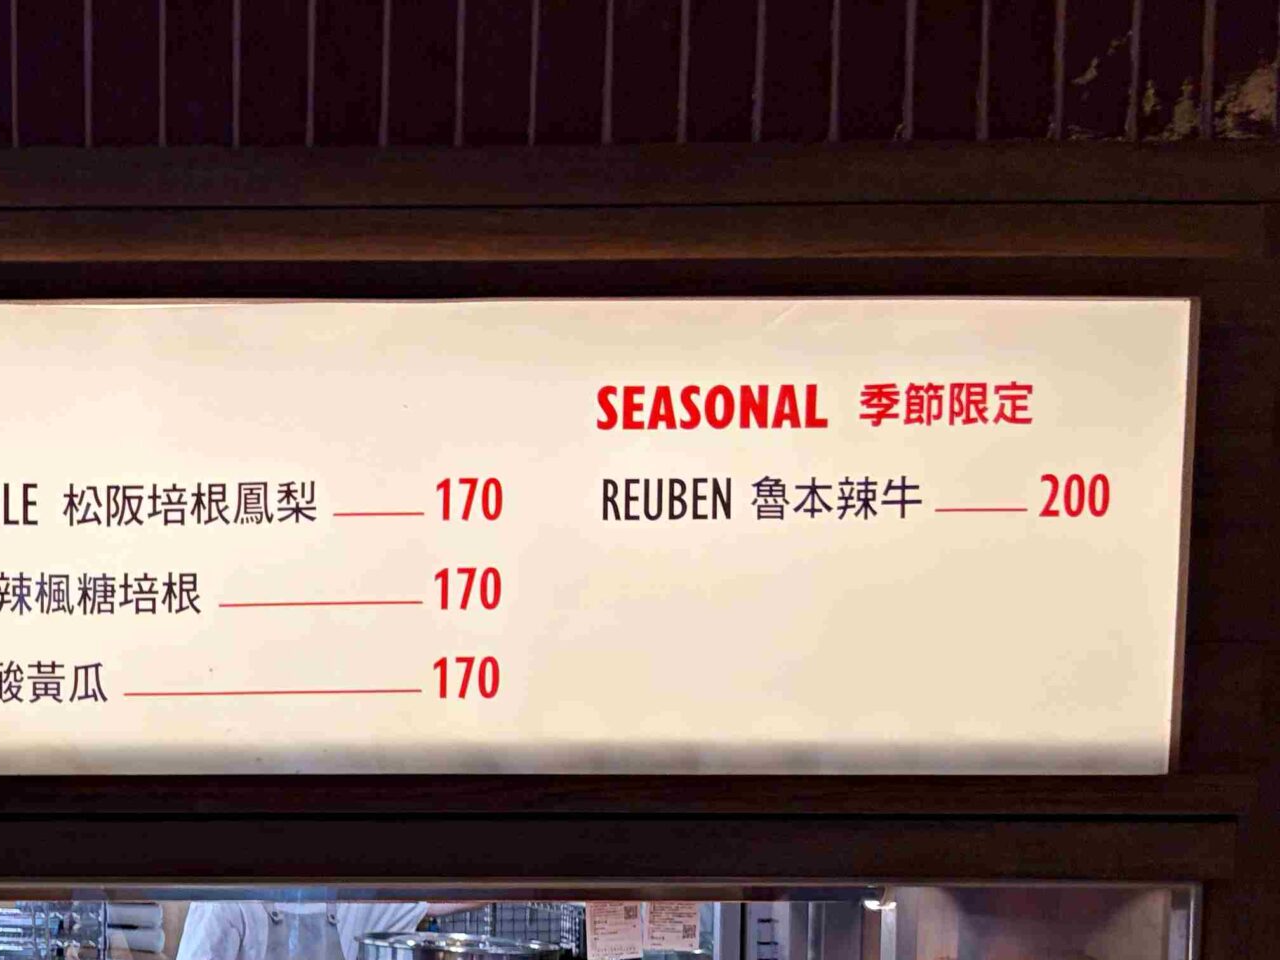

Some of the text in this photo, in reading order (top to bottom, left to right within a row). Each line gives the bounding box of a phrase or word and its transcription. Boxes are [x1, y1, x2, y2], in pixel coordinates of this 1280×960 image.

[596, 380, 1034, 431] SEASONAL 季節限定
[62, 480, 317, 528] 松阪培根鳳梨
[436, 477, 503, 522] 170
[602, 473, 1111, 522] REUBEN 魯本辣牛 200
[434, 566, 502, 611] 170
[433, 655, 500, 700] 170
